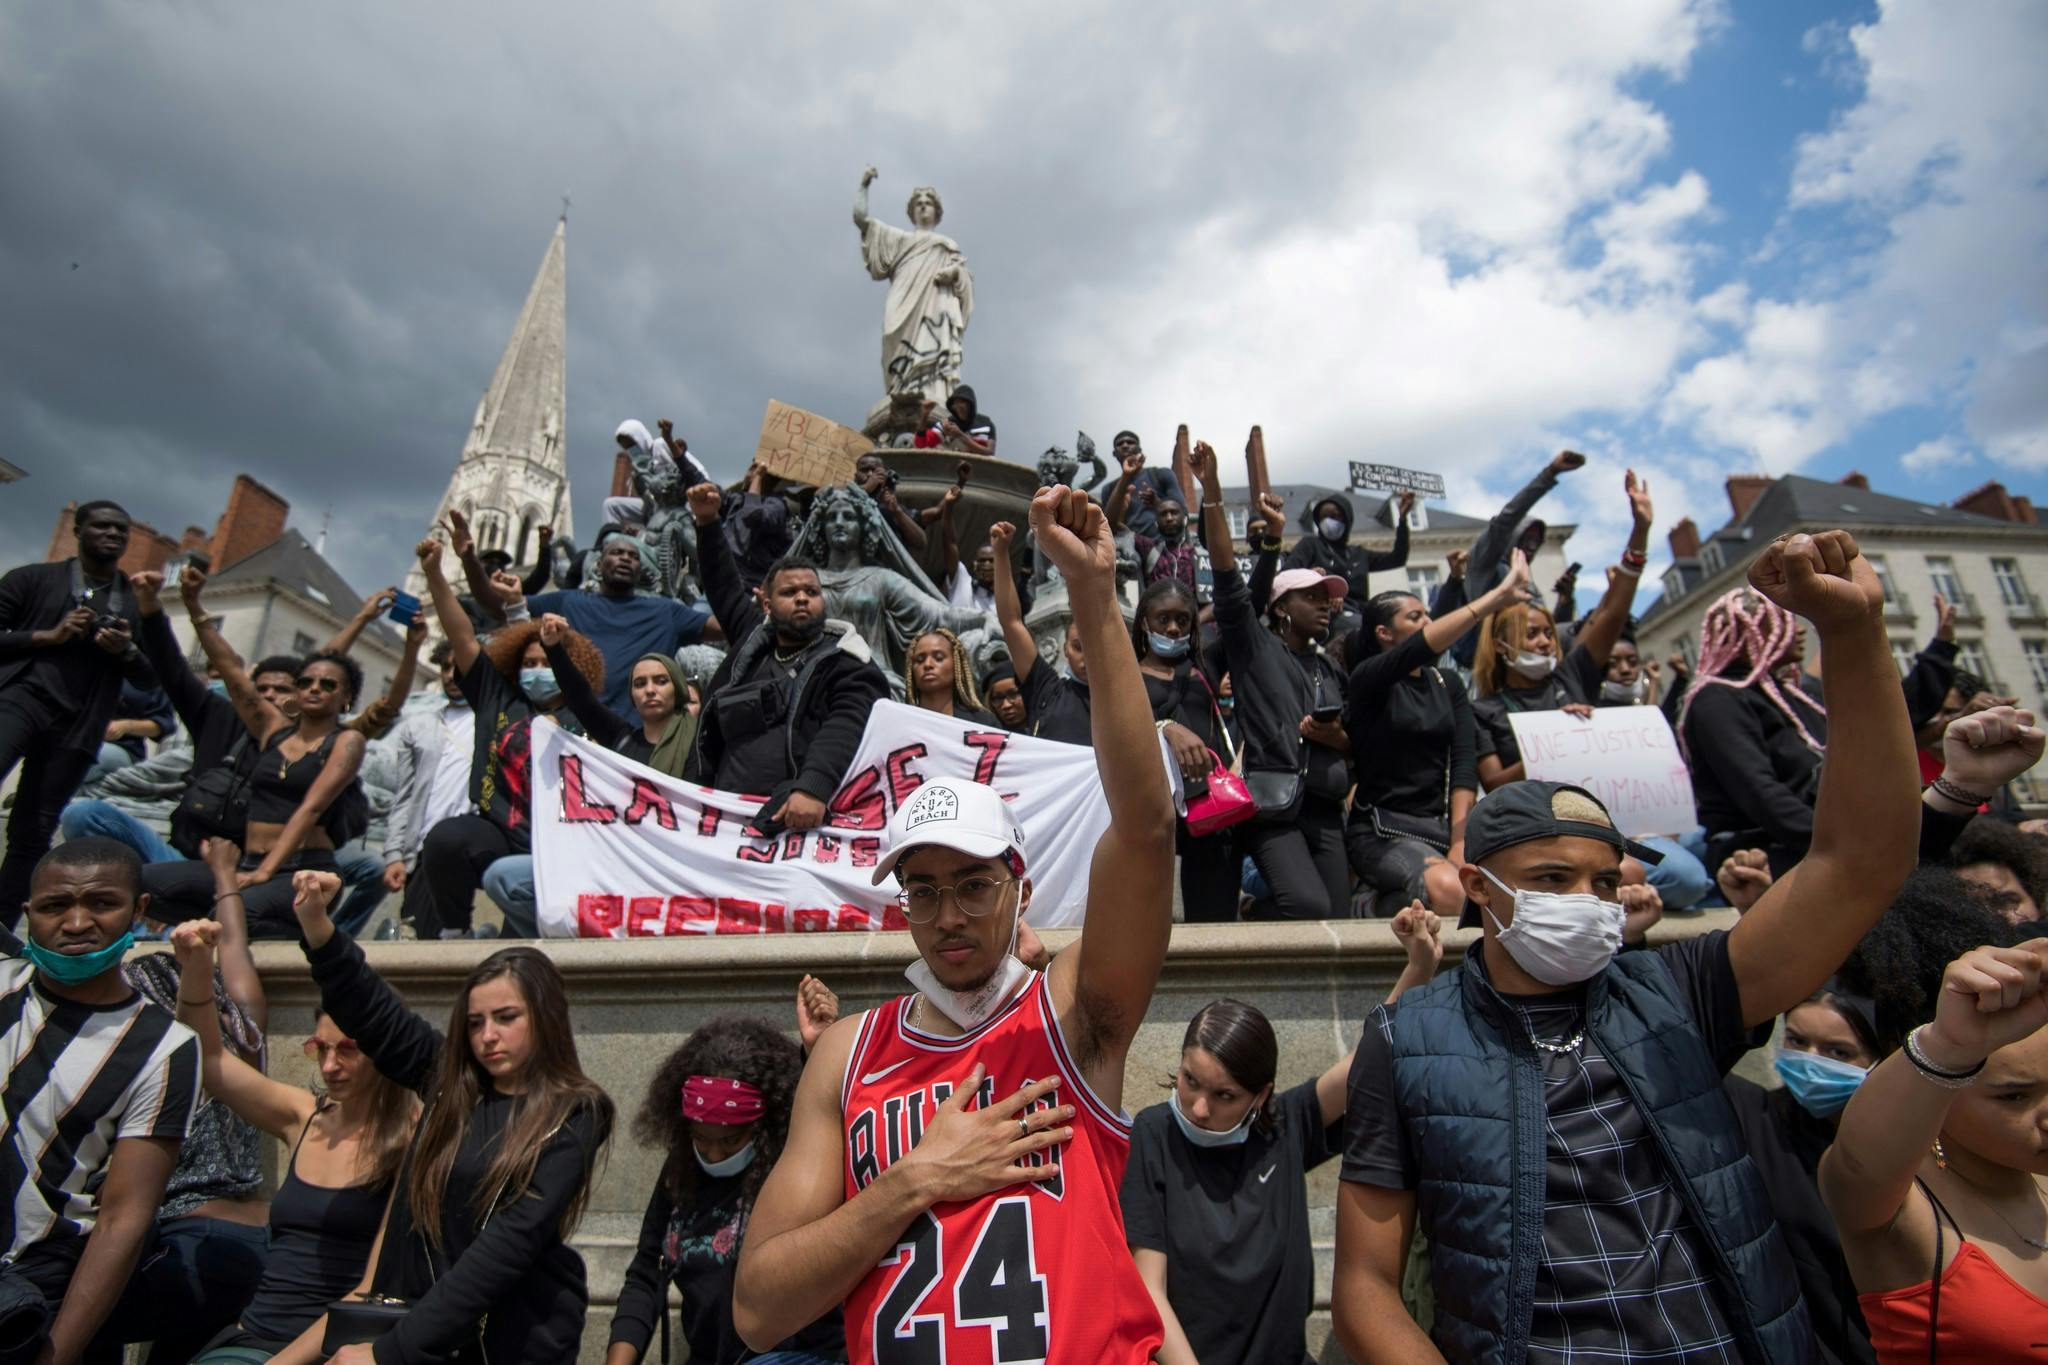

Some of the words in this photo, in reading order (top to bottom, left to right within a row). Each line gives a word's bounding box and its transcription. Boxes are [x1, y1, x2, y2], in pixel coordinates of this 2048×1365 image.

[787, 434, 853, 475] LIVES
[1520, 731, 1567, 763] UNE
[1571, 727, 1671, 754] JUSTICE
[914, 810, 949, 824] BEACH
[873, 1196, 1050, 1365] 24
